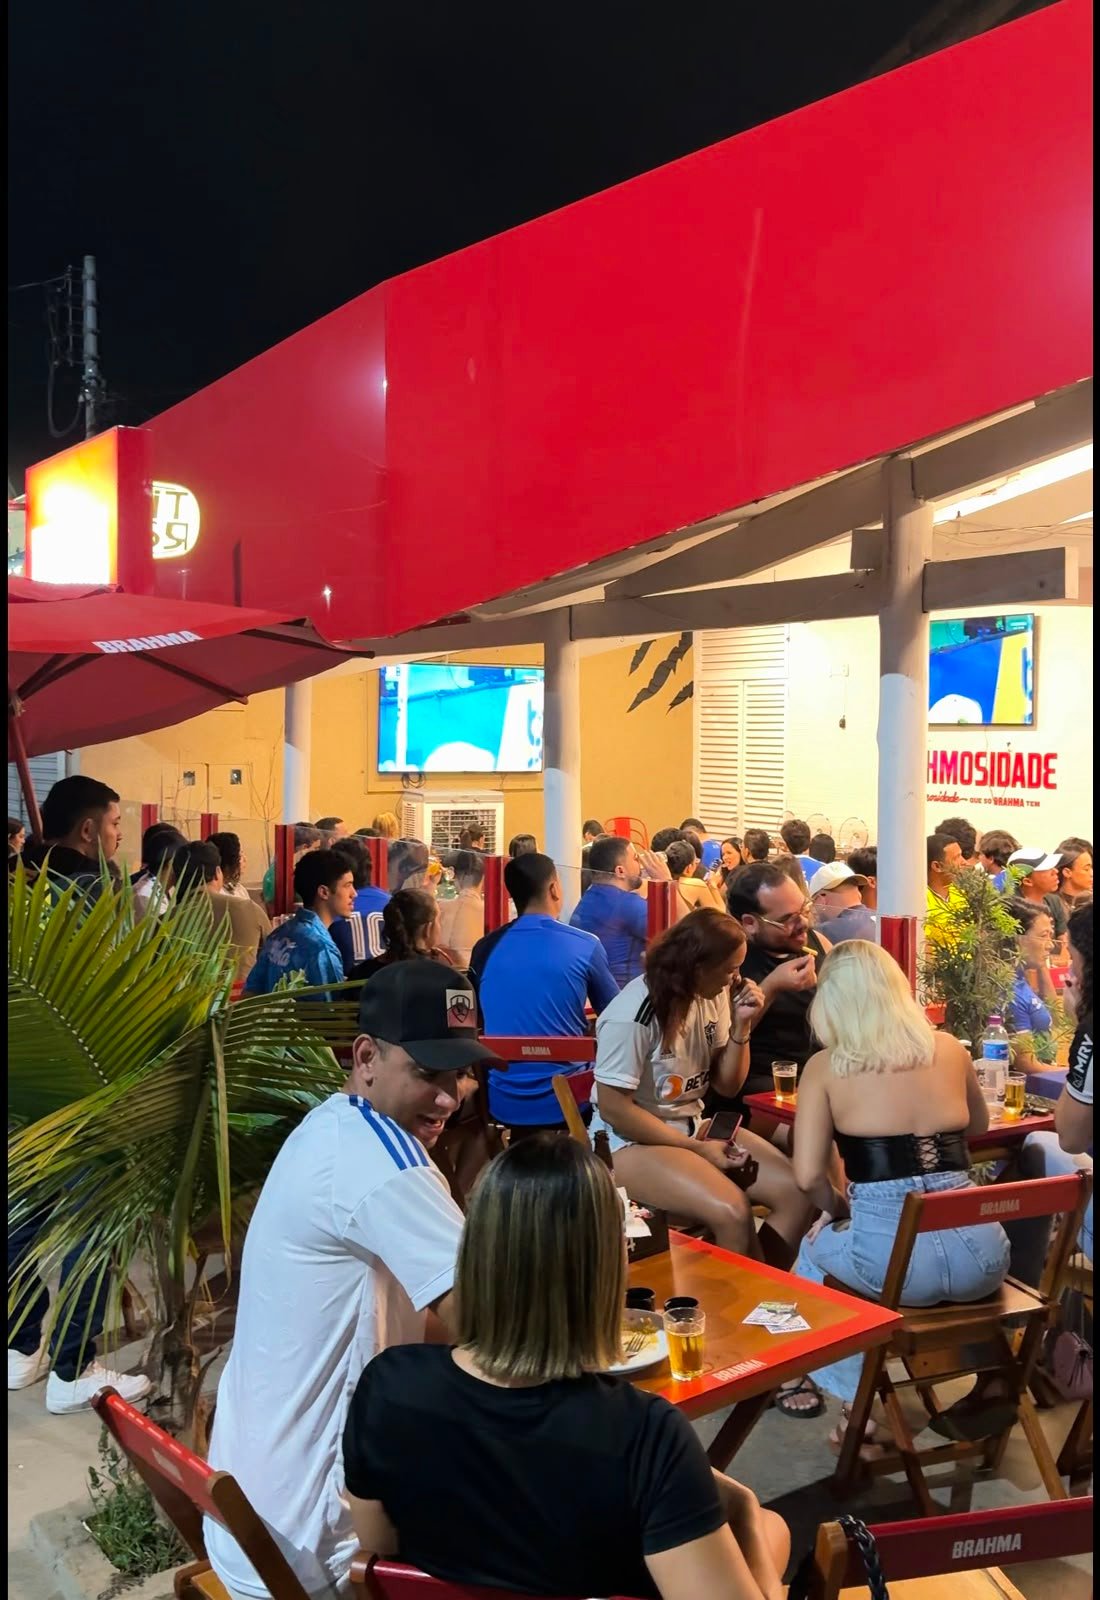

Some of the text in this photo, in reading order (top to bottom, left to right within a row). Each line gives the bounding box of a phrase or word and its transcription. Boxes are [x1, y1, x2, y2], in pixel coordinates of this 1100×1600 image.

[91, 630, 204, 653] BRAHMA
[993, 796, 1025, 808] BRAHMA
[345, 911, 388, 960] 10
[521, 1046, 551, 1056] BRAHMA
[980, 1199, 1020, 1216] BRAHMA
[711, 1359, 768, 1382] BRAHMA
[951, 1533, 1022, 1559] BRAHMA
